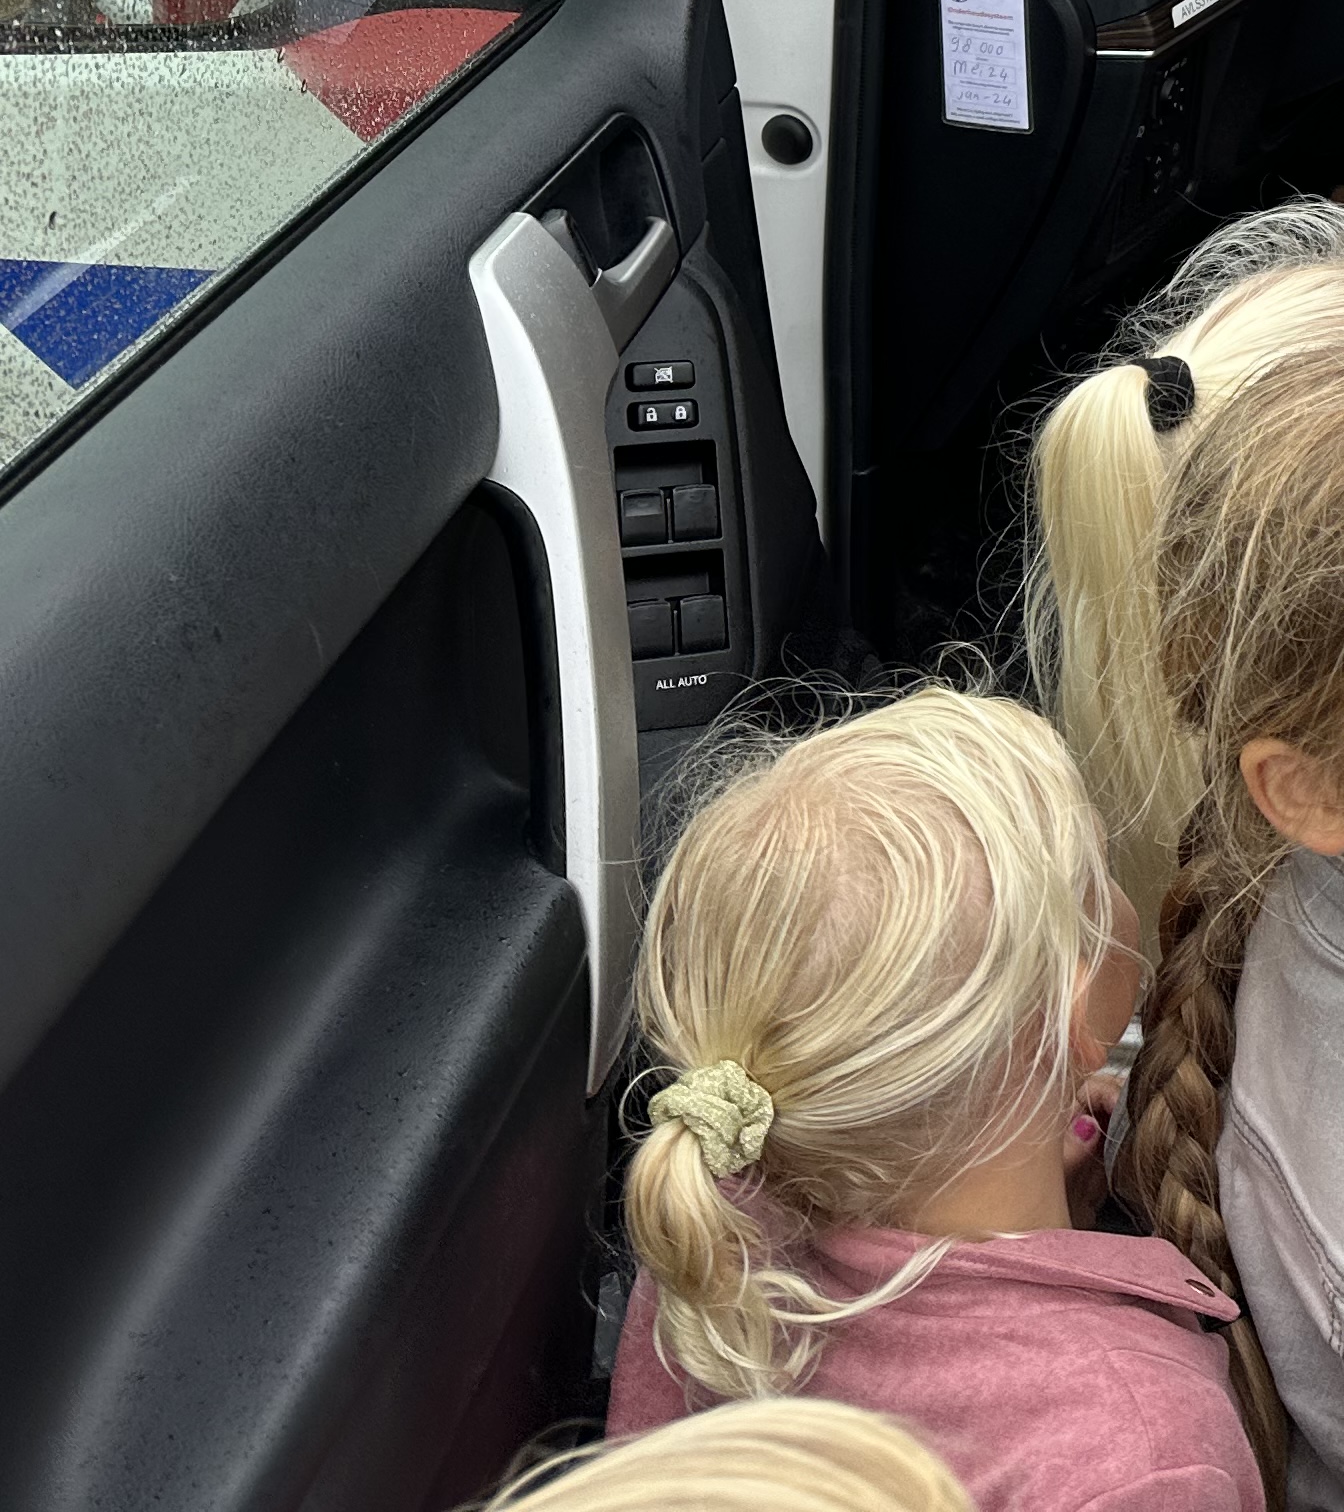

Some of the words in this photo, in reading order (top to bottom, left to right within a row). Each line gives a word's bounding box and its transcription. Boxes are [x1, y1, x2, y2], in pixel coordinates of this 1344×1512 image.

[951, 37, 973, 53] 98
[979, 42, 1004, 56] 000
[655, 679, 676, 691] ALL
[678, 674, 707, 688] AUTO
